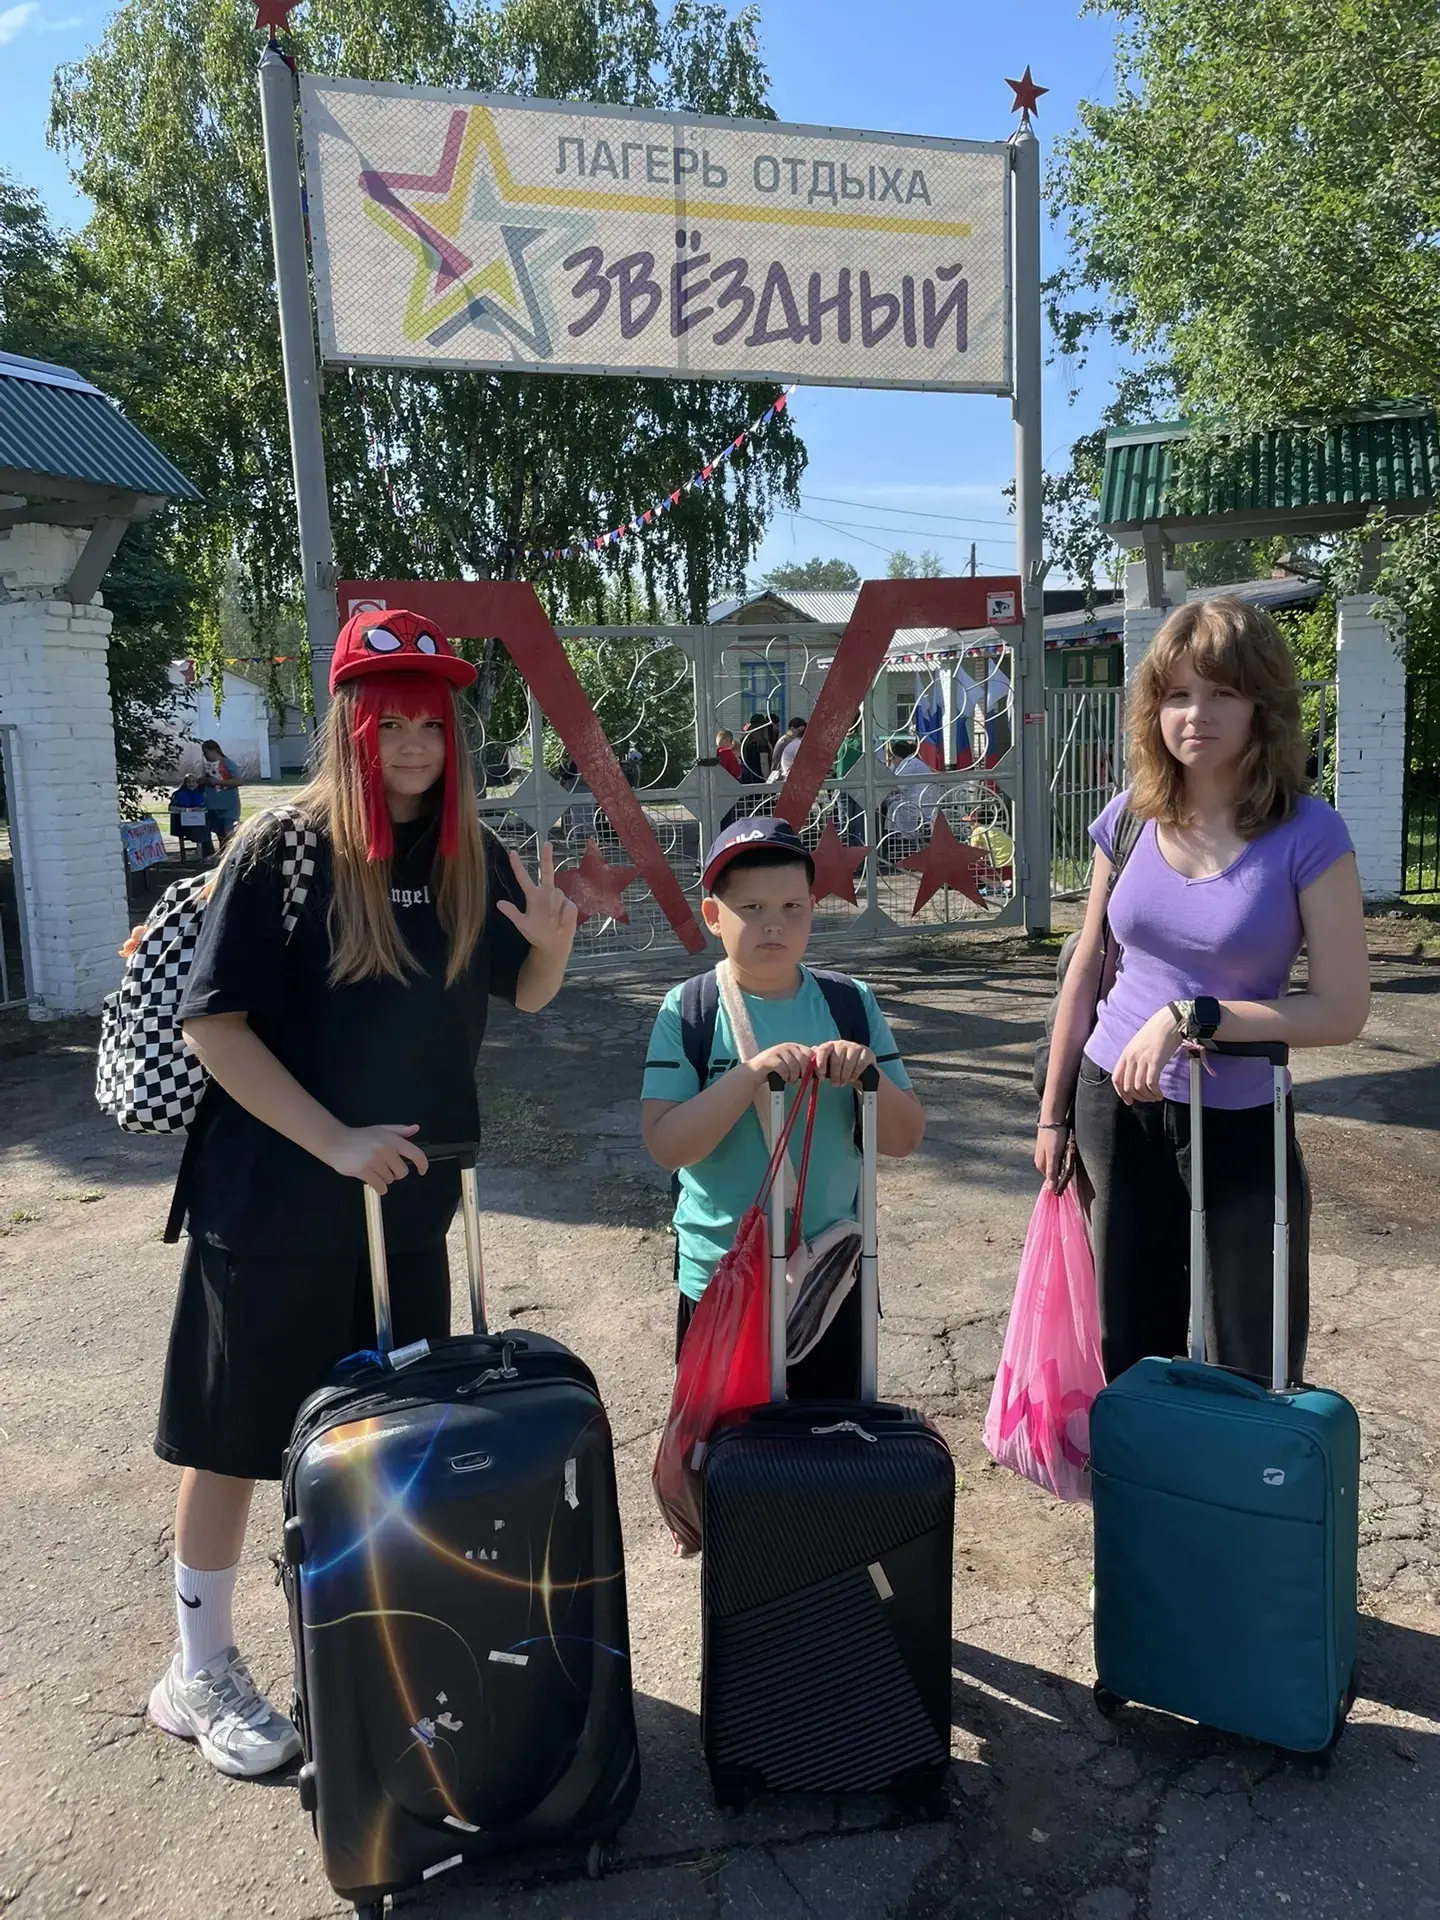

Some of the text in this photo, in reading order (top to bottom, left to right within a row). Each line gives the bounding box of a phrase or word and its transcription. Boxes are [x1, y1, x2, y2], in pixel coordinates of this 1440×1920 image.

[555, 136, 932, 206] ЛАГЕРЬ ОТДЫХА
[562, 229, 969, 352] ЗВЁЗДНЫЙ
[388, 885, 431, 908] ngel
